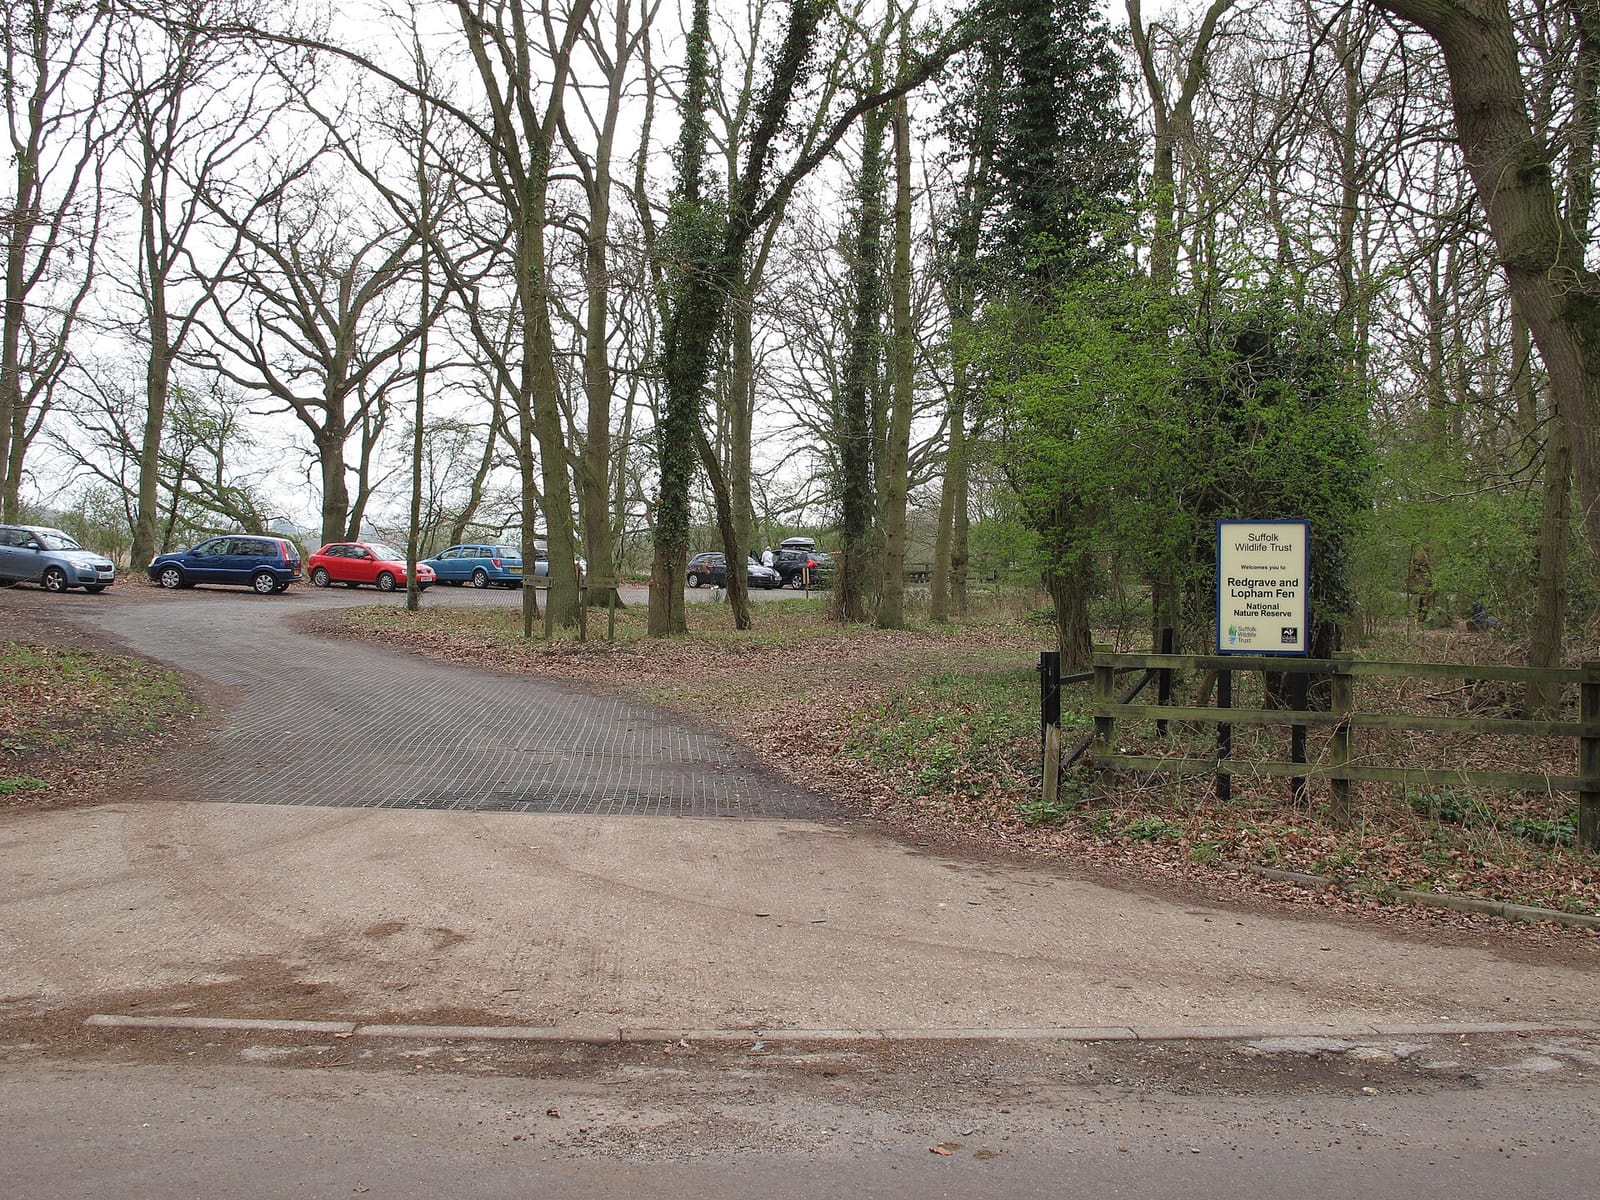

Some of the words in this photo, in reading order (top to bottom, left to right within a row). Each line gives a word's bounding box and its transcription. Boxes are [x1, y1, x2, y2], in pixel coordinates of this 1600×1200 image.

[1248, 533, 1279, 542] Suffolk
[1235, 543, 1267, 552] Wildlife
[1270, 543, 1292, 552] Trust
[1228, 578, 1276, 589] Redgrave
[1279, 578, 1298, 587] and
[1231, 589, 1273, 600] Lopham
[1276, 589, 1295, 598] Fen
